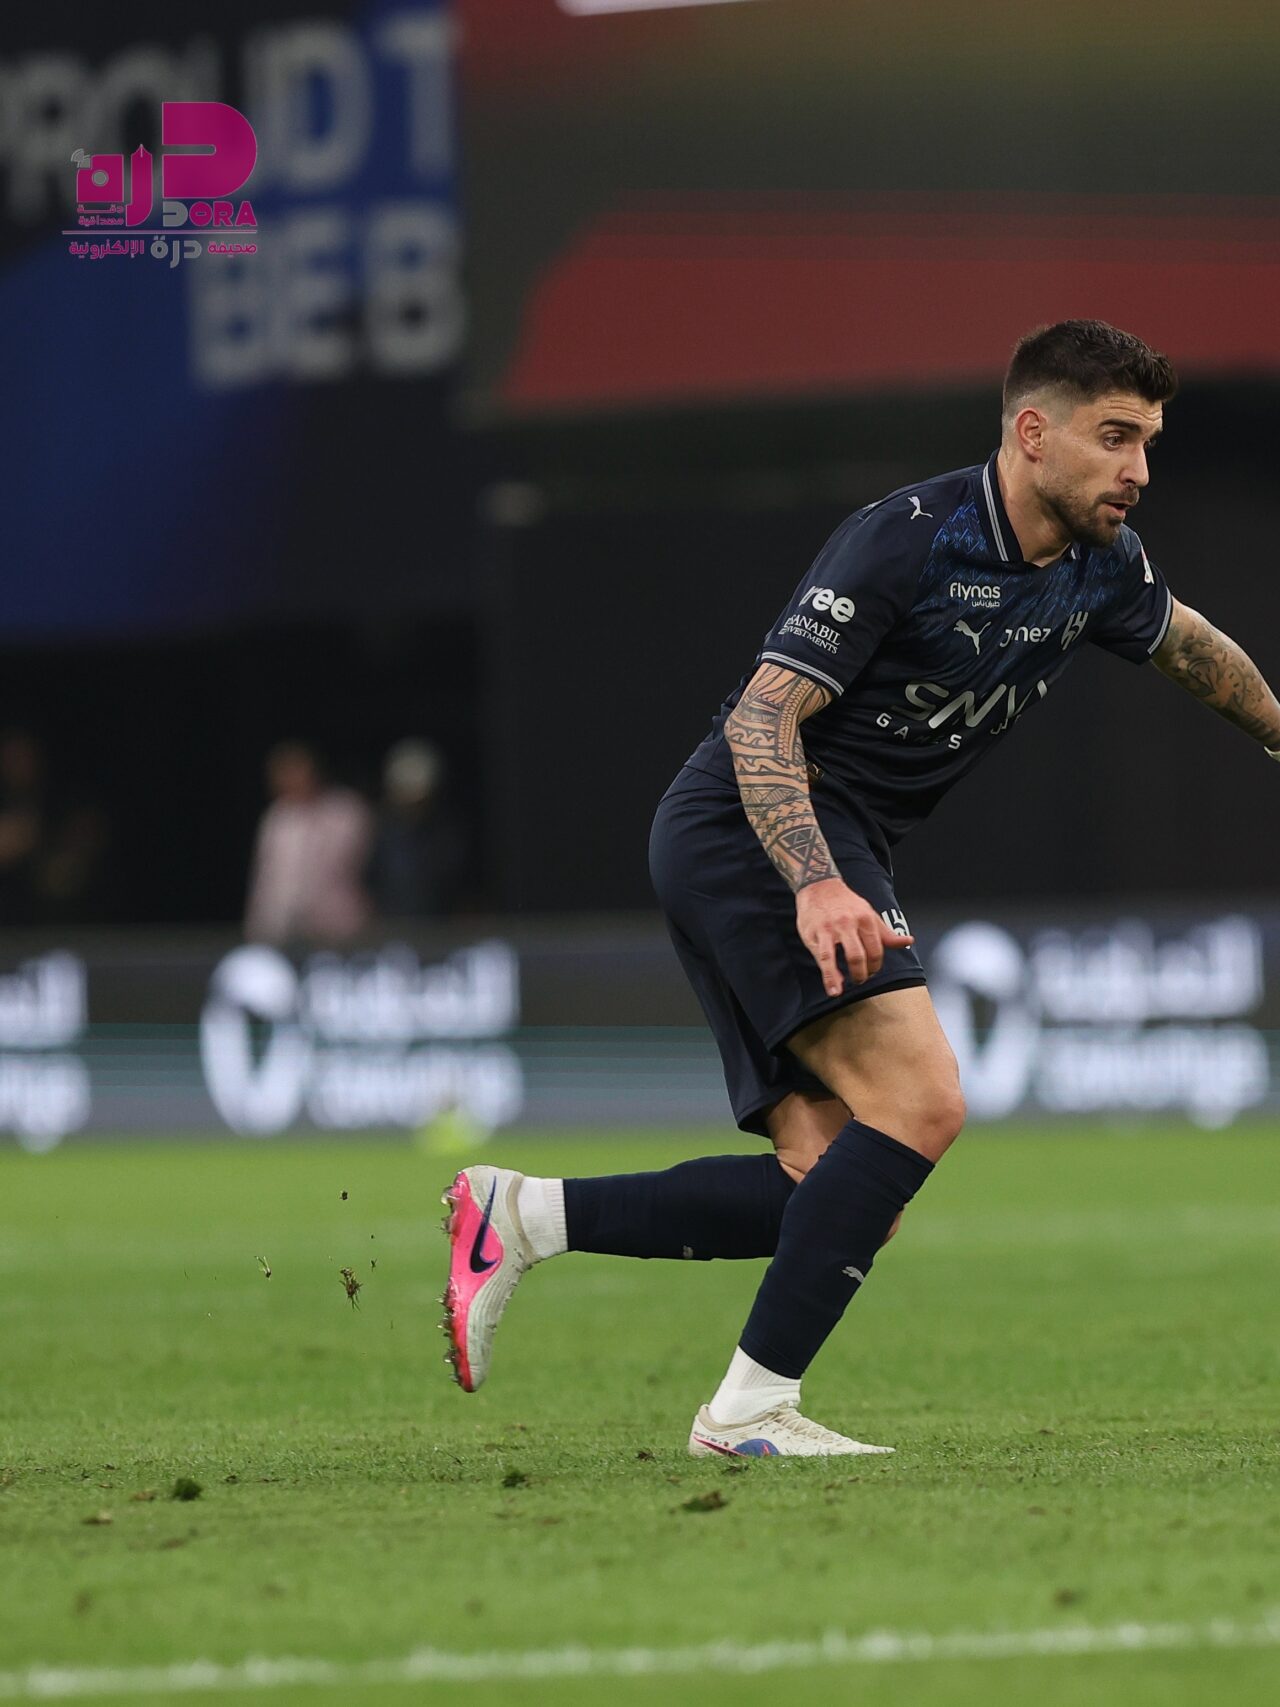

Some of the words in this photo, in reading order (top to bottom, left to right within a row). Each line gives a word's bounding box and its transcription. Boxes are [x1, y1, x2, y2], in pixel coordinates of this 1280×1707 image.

[799, 586, 855, 623] ree
[950, 582, 1001, 601] flynas
[778, 625, 838, 654] NVESTMENTS
[876, 712, 963, 750] GAS
